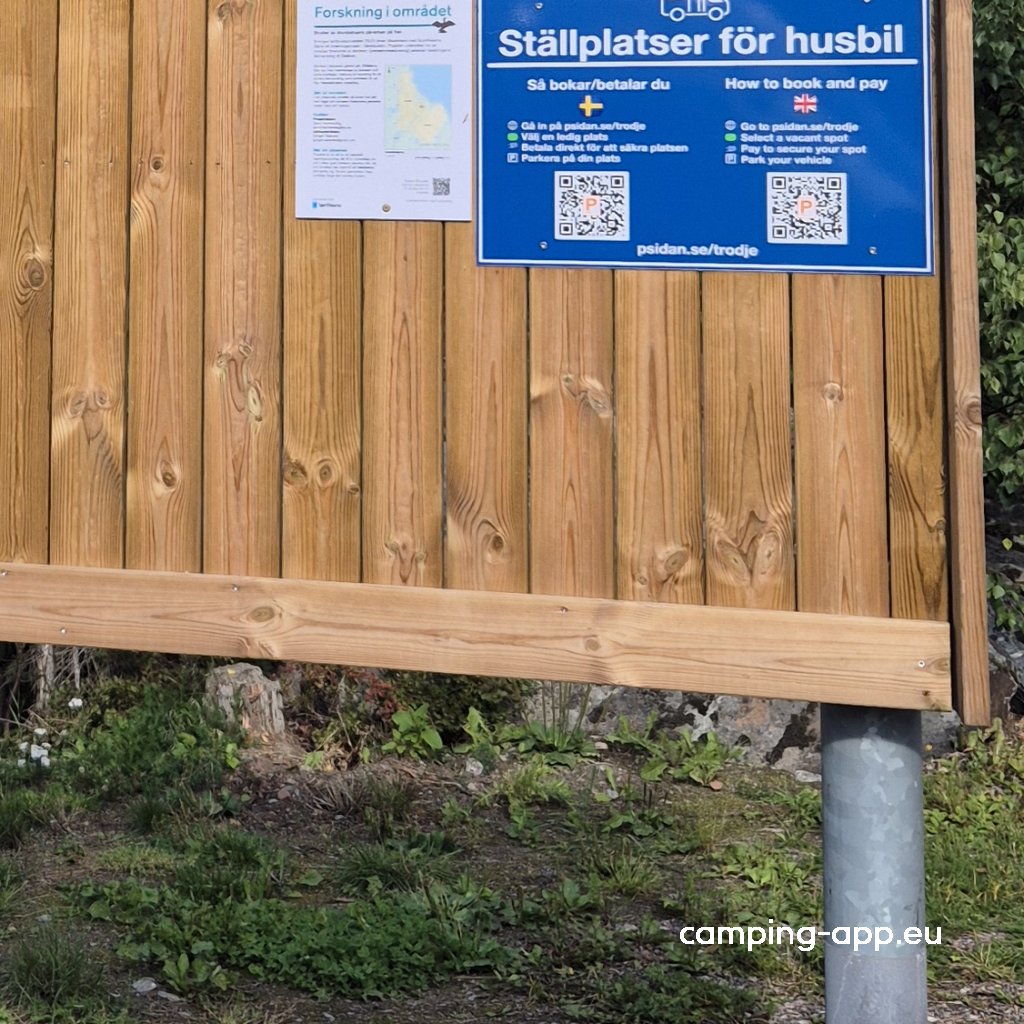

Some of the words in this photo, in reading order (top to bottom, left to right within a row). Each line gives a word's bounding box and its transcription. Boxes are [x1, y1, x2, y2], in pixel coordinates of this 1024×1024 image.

[314, 5, 383, 20] Forskning
[392, 3, 452, 18] området
[498, 28, 709, 63] Ställplatser
[718, 26, 775, 56] för
[785, 24, 904, 55] husbil
[526, 77, 546, 91] Så
[549, 78, 649, 91] bokar/betalar
[652, 78, 671, 91] du
[724, 78, 760, 90] How
[763, 78, 779, 90] to
[783, 77, 823, 90] book
[825, 77, 856, 89] and
[858, 78, 888, 92] pay
[521, 120, 535, 131] Gå
[537, 121, 547, 130] in
[549, 120, 562, 132] på
[564, 121, 646, 132] psidan.se/trodje
[740, 122, 756, 131] Go
[758, 123, 770, 131] to
[771, 122, 859, 132] psidan.se/trodje
[521, 133, 540, 143] Välj
[556, 133, 581, 143] ledig
[583, 133, 609, 143] plats
[740, 133, 774, 142] Select
[785, 134, 822, 142] vacant
[823, 134, 849, 144] spot
[521, 143, 554, 153] Betala
[555, 143, 586, 153] direkt
[587, 143, 602, 153] för
[603, 144, 618, 153] att
[619, 143, 648, 153] säkra
[650, 144, 689, 154] platsen
[740, 144, 761, 154] Pay
[763, 145, 774, 153] to
[815, 146, 840, 155] your
[841, 145, 867, 155] spot
[521, 154, 560, 163] Parkera
[562, 153, 576, 164] på
[577, 153, 594, 163] din
[595, 154, 621, 164] plats
[740, 155, 766, 164] Park
[767, 157, 791, 165] your
[793, 156, 832, 164] vehicle
[636, 242, 758, 258] psidan.se/trodje
